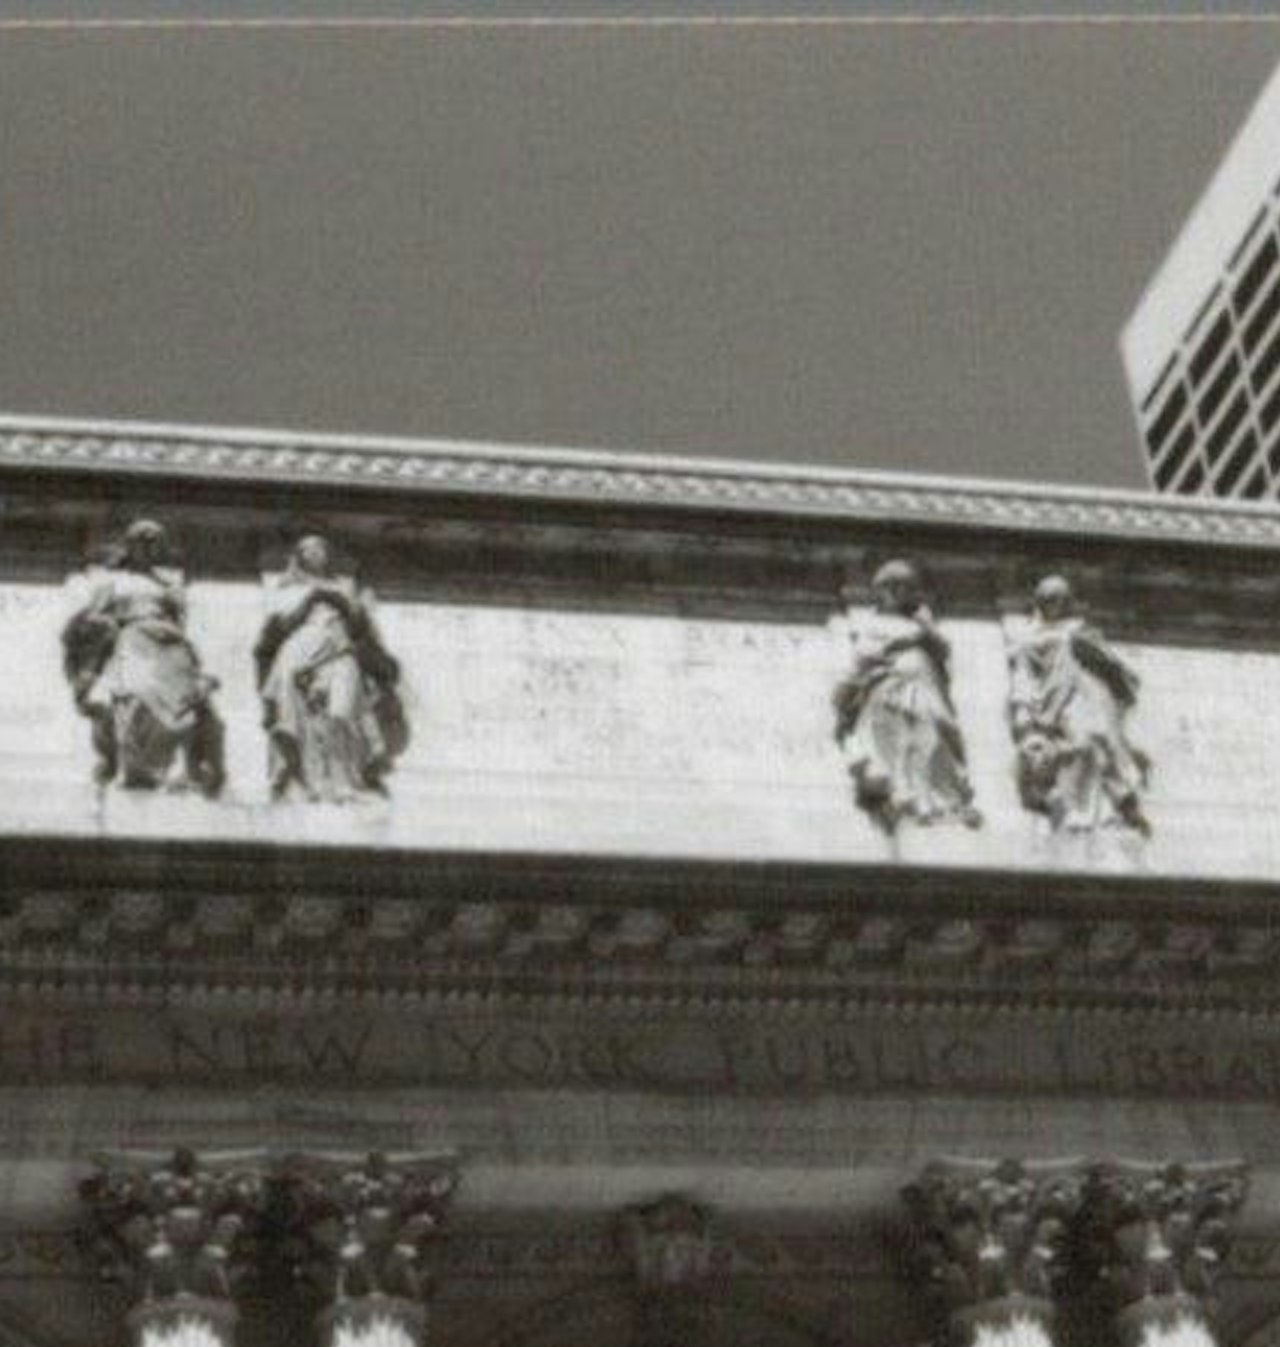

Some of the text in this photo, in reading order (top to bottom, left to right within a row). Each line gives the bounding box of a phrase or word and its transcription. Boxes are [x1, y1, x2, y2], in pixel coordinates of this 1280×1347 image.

[170, 1022, 377, 1073] NEW
[447, 1027, 649, 1081] YORK
[722, 1033, 983, 1086] PUBLIC
